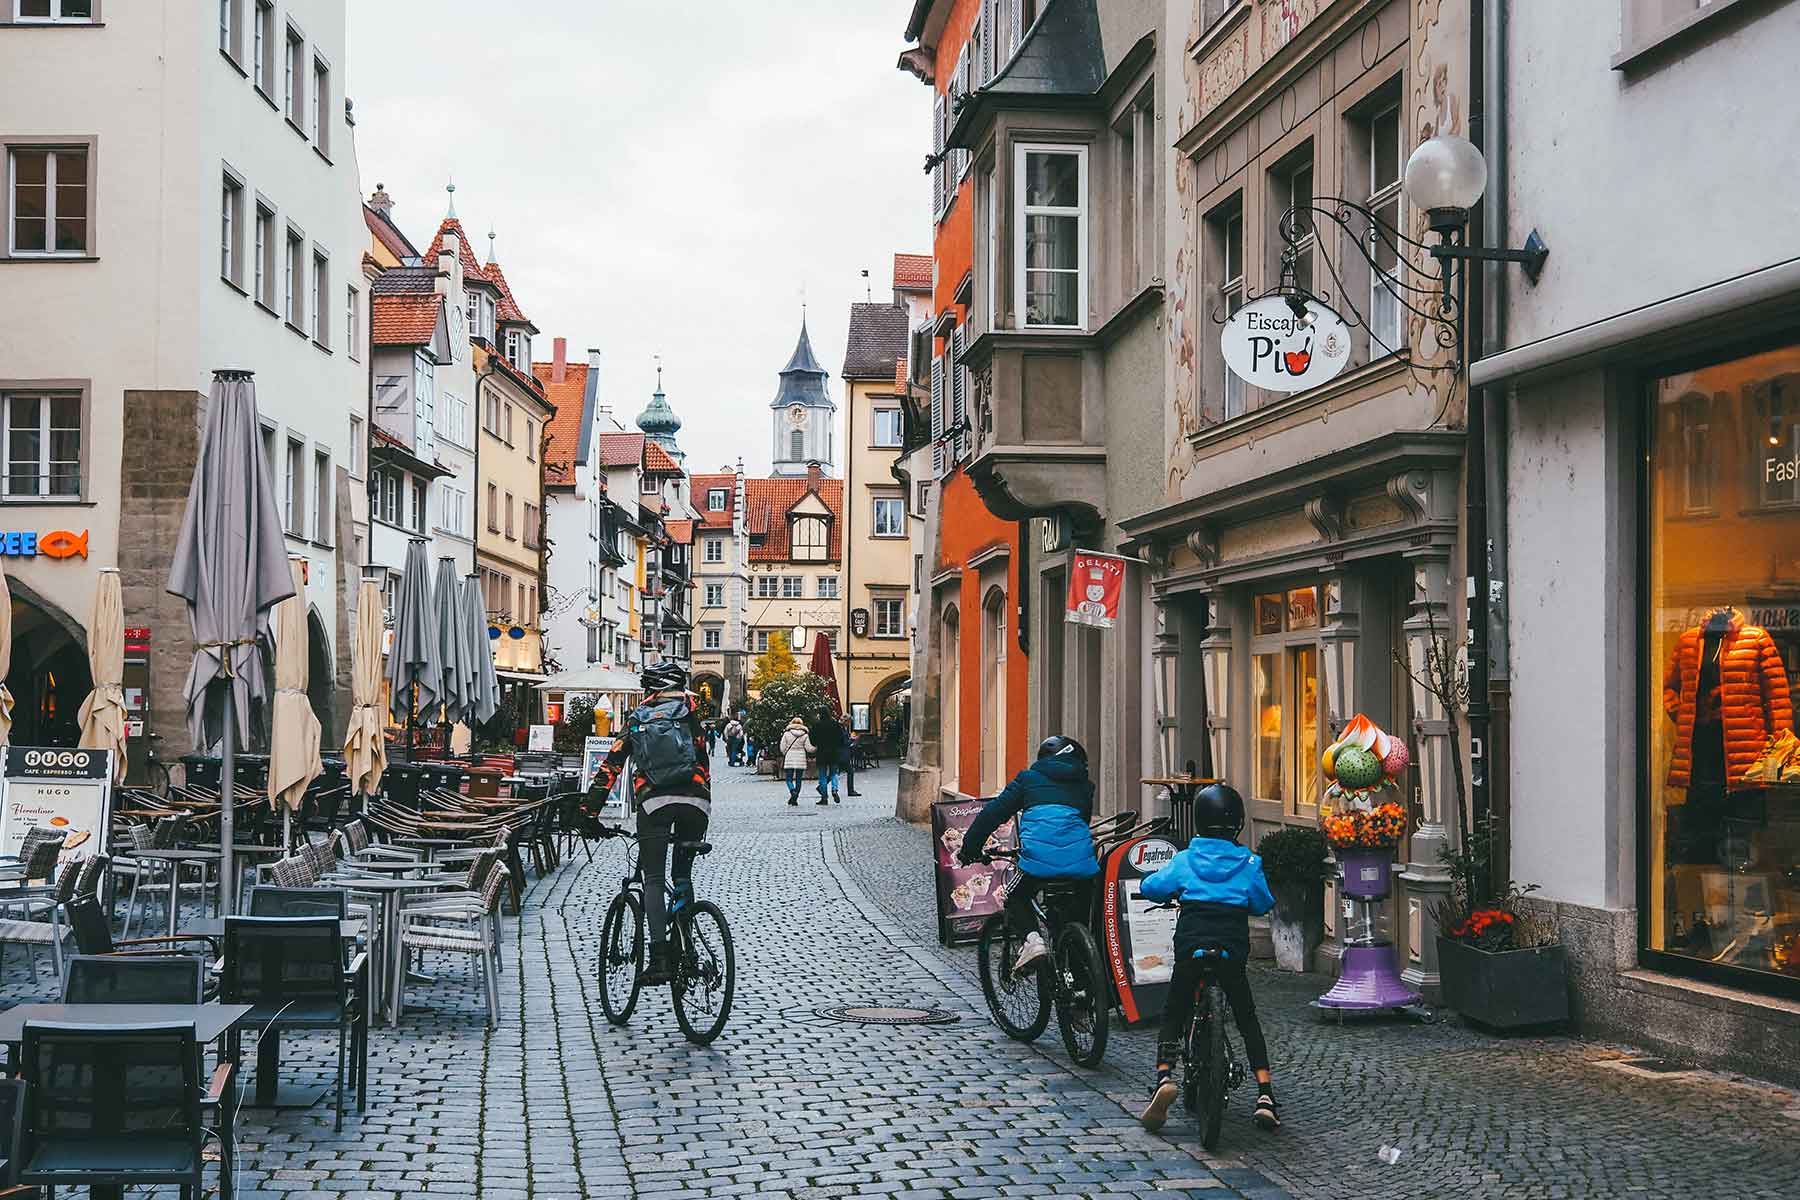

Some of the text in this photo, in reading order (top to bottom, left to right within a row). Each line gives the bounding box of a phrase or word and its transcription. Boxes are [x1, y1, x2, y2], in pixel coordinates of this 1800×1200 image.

[1246, 311, 1304, 337] Eiscaf
[1078, 560, 1120, 576] GELATI
[25, 750, 90, 767] HUGO
[1106, 881, 1114, 915] italiano
[1107, 918, 1119, 957] espresso
[1114, 958, 1124, 978] vero
